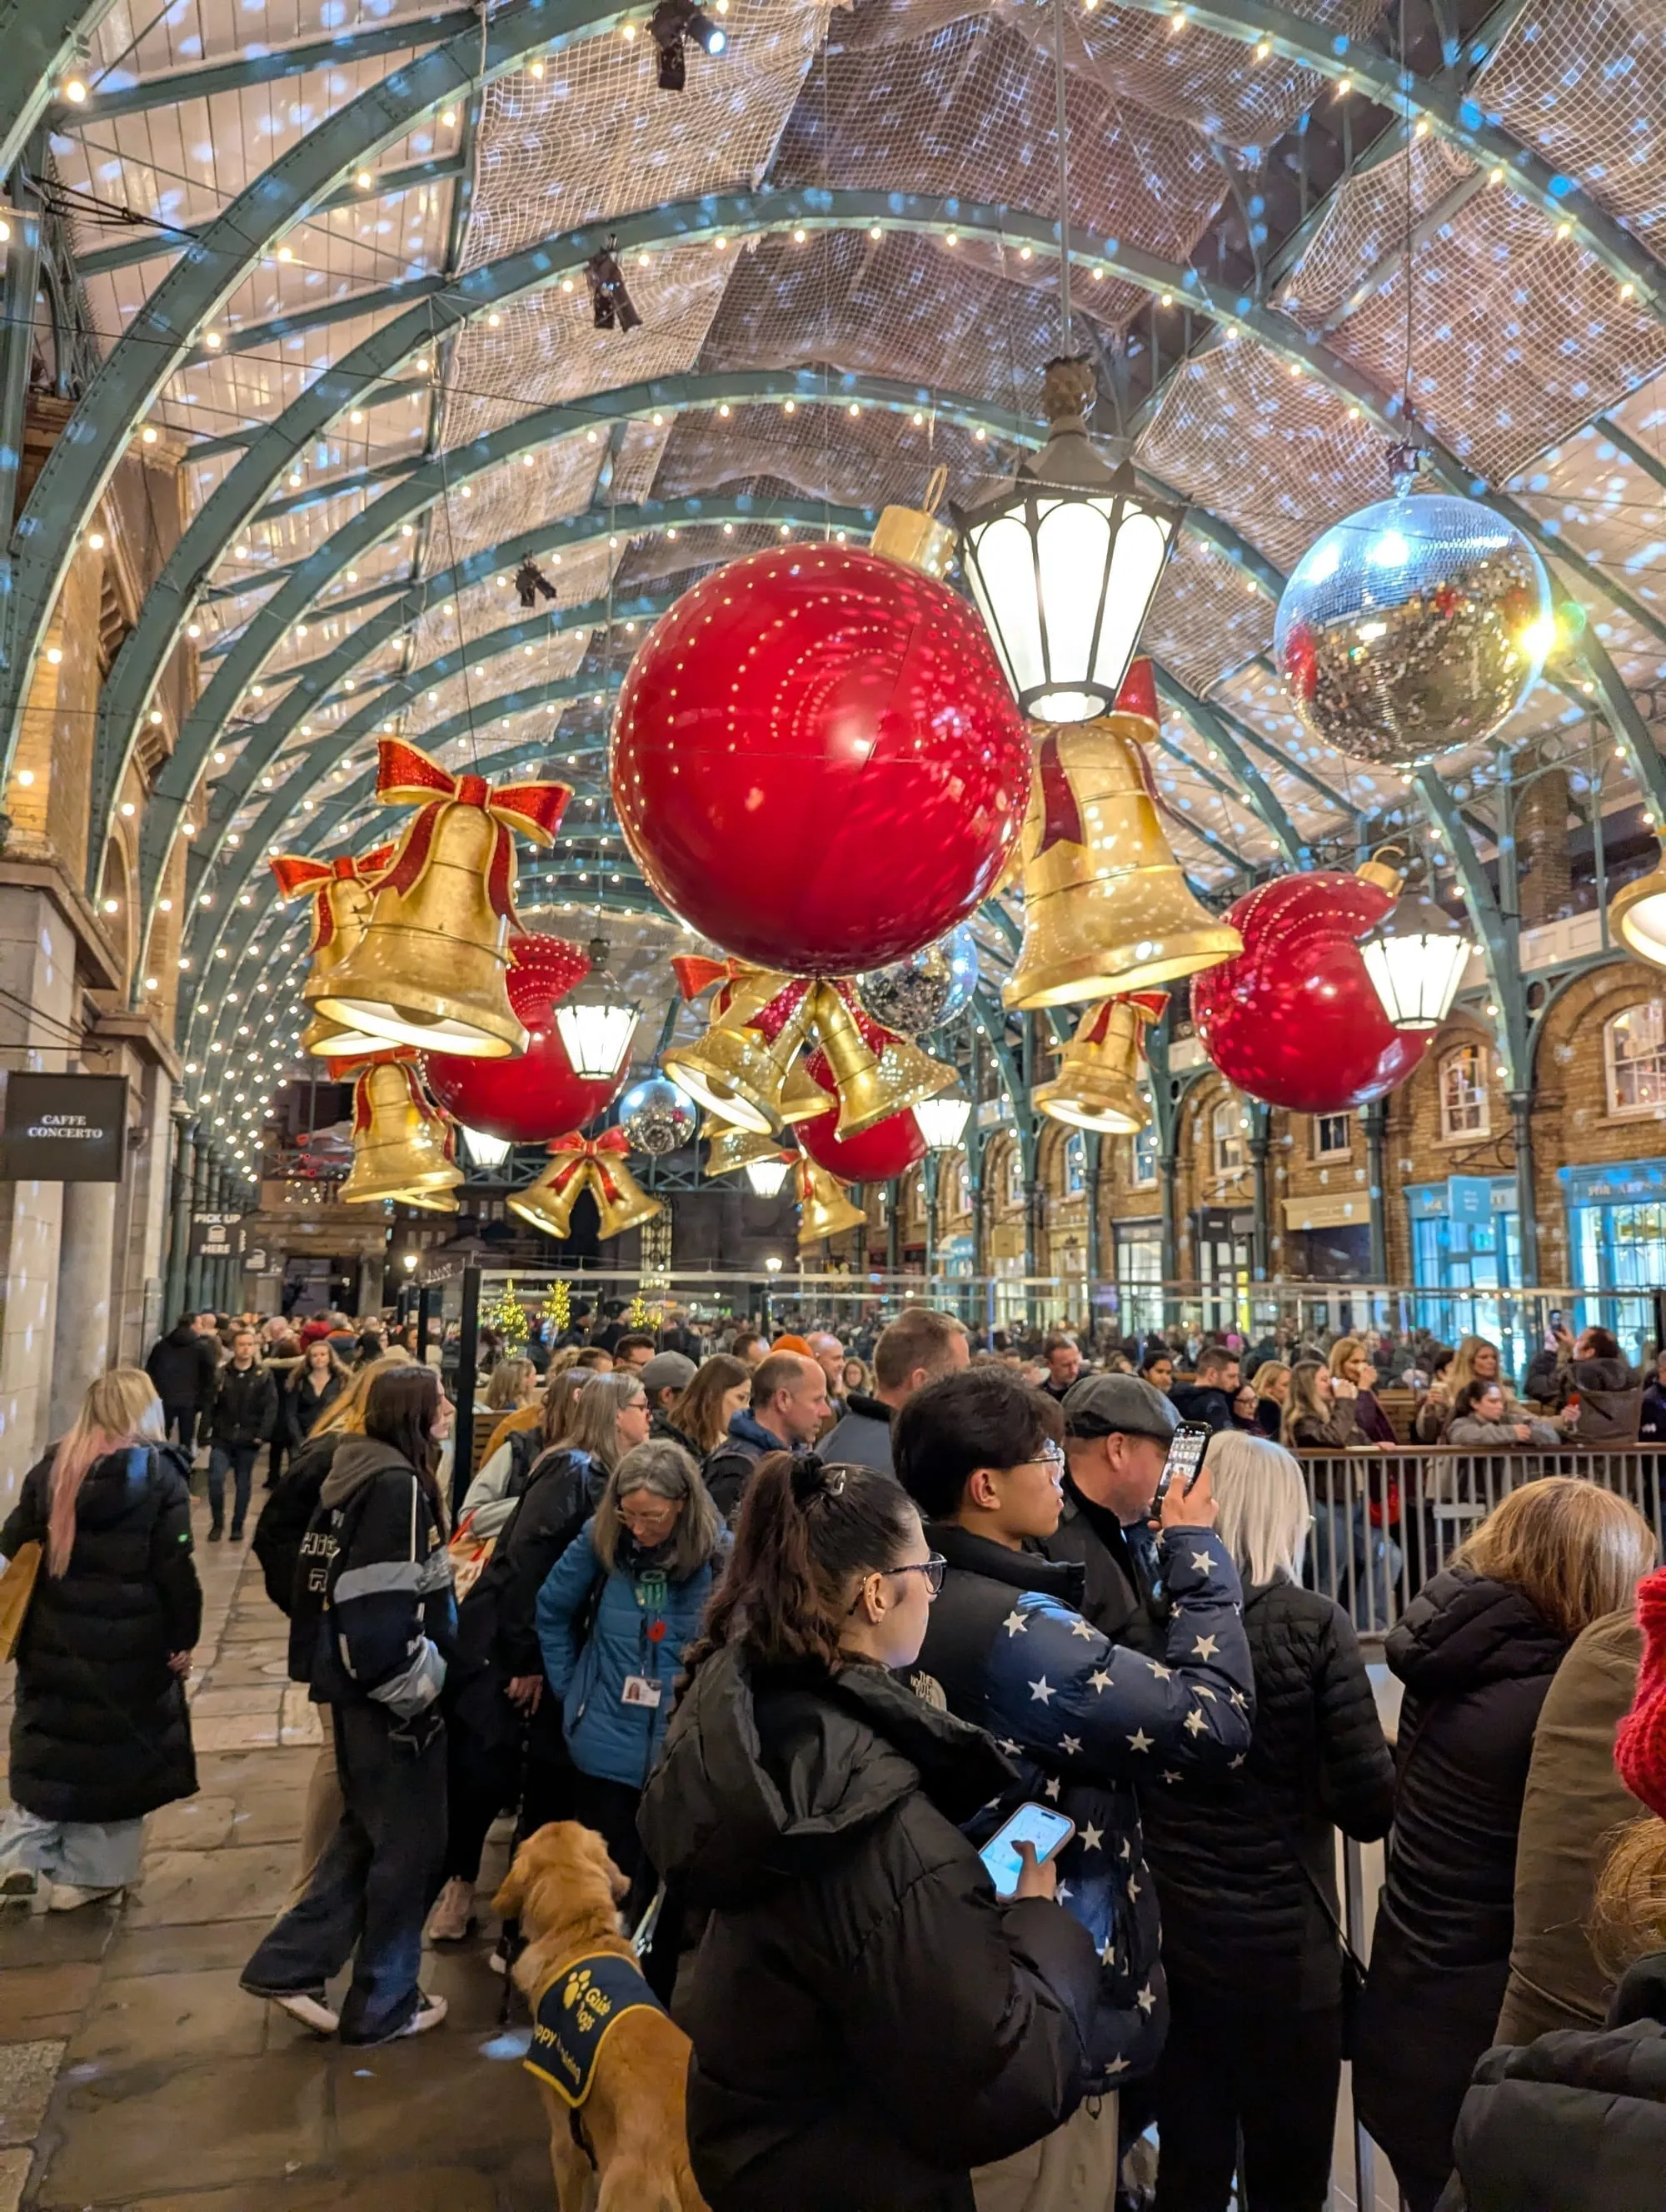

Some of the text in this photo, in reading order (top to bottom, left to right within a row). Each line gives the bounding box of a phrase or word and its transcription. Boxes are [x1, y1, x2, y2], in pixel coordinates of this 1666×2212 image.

[41, 1114, 87, 1126] CAFFE
[27, 1127, 103, 1138] CONCERTO
[193, 1213, 241, 1224] PICK UP
[199, 1243, 231, 1254] HERE
[586, 1987, 612, 2016] Guide
